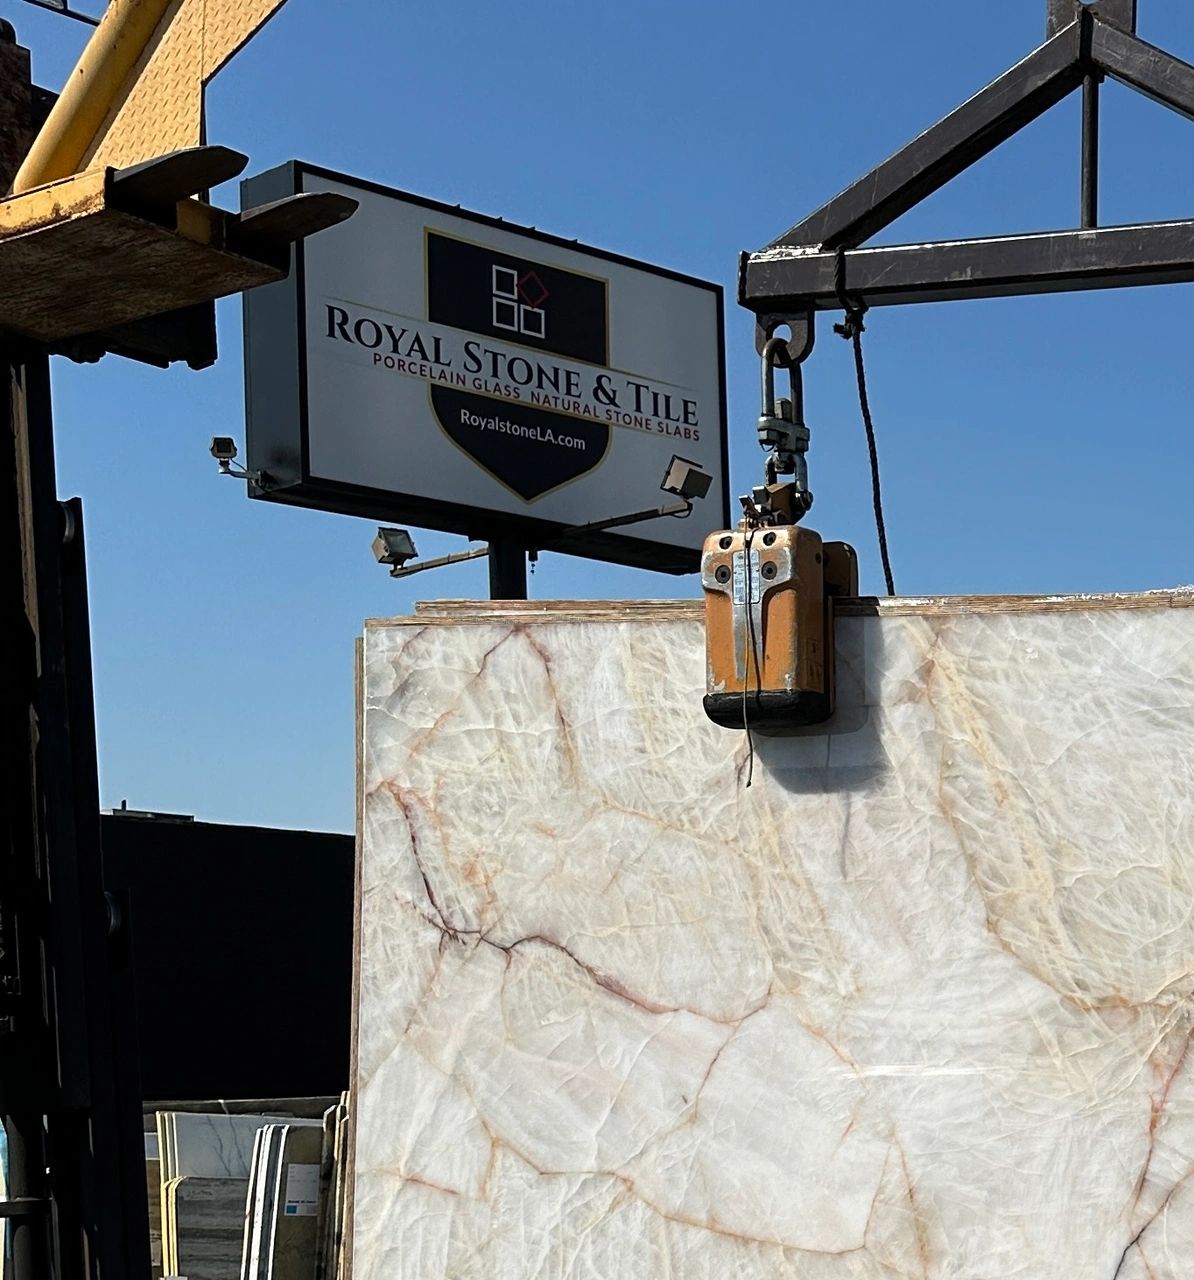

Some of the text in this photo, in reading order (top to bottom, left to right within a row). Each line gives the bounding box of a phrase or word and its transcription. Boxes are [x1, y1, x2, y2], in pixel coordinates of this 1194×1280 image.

[325, 304, 699, 427] ROYAL STONE & TILE
[373, 353, 701, 442] PORCELAIN GLASS NATURAL STONE SLABS
[460, 408, 586, 451] RoyalstoneLA.com
